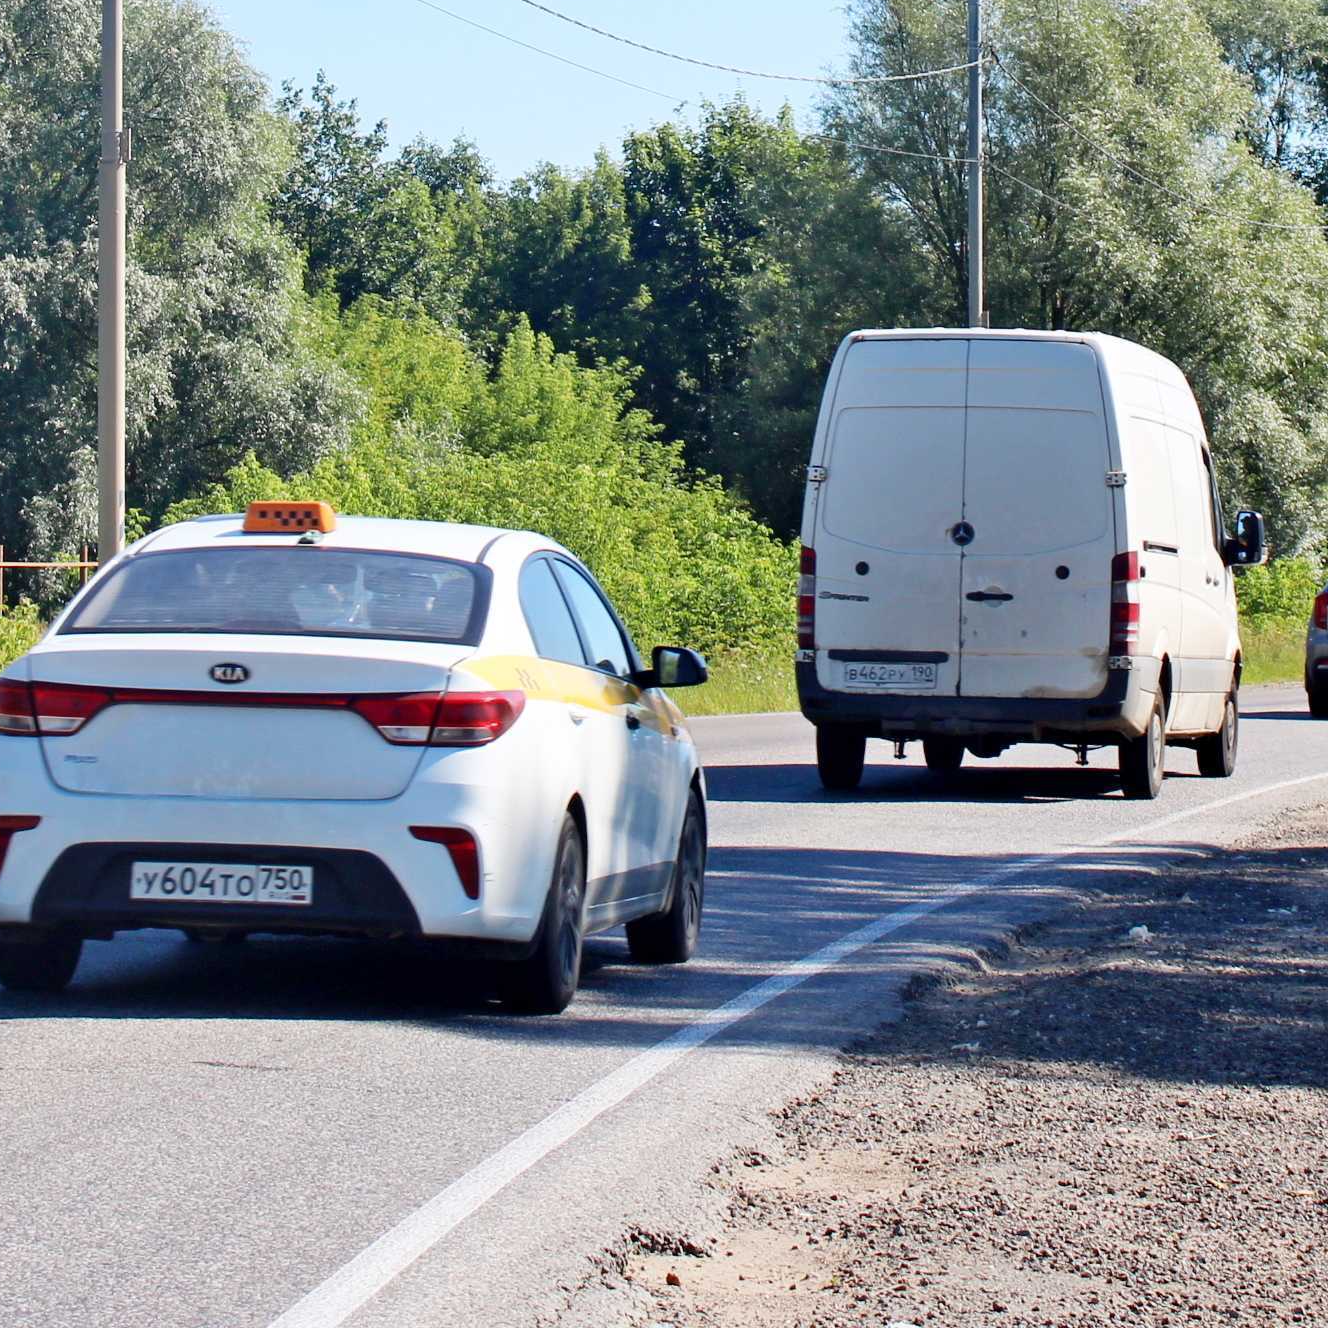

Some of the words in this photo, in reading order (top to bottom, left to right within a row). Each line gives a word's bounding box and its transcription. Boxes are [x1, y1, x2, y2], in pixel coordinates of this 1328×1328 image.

[214, 667, 245, 681] KIA
[144, 867, 255, 897] У604ТО
[261, 868, 304, 890] 750
